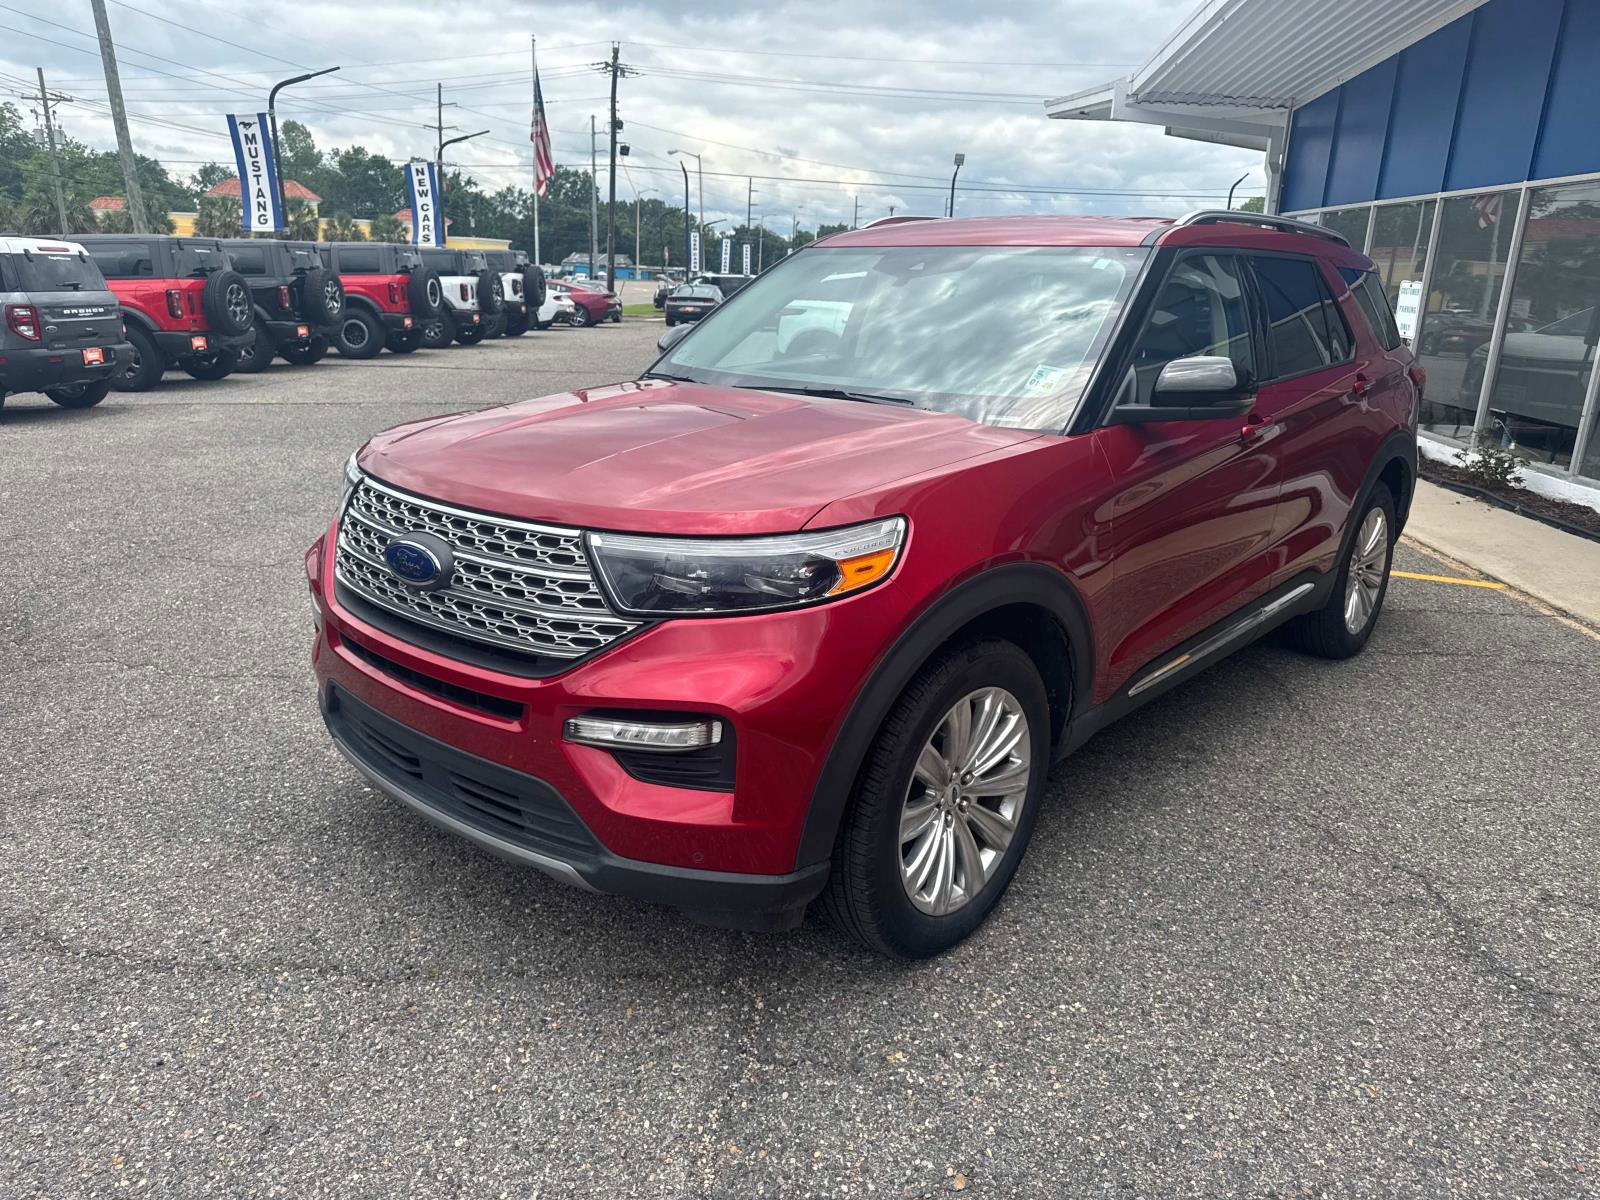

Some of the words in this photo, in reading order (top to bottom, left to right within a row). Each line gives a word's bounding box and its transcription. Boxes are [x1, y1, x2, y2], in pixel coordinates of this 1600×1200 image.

[244, 133, 269, 225] MUSTANG
[415, 167, 429, 198] NEW
[420, 203, 431, 243] CARS
